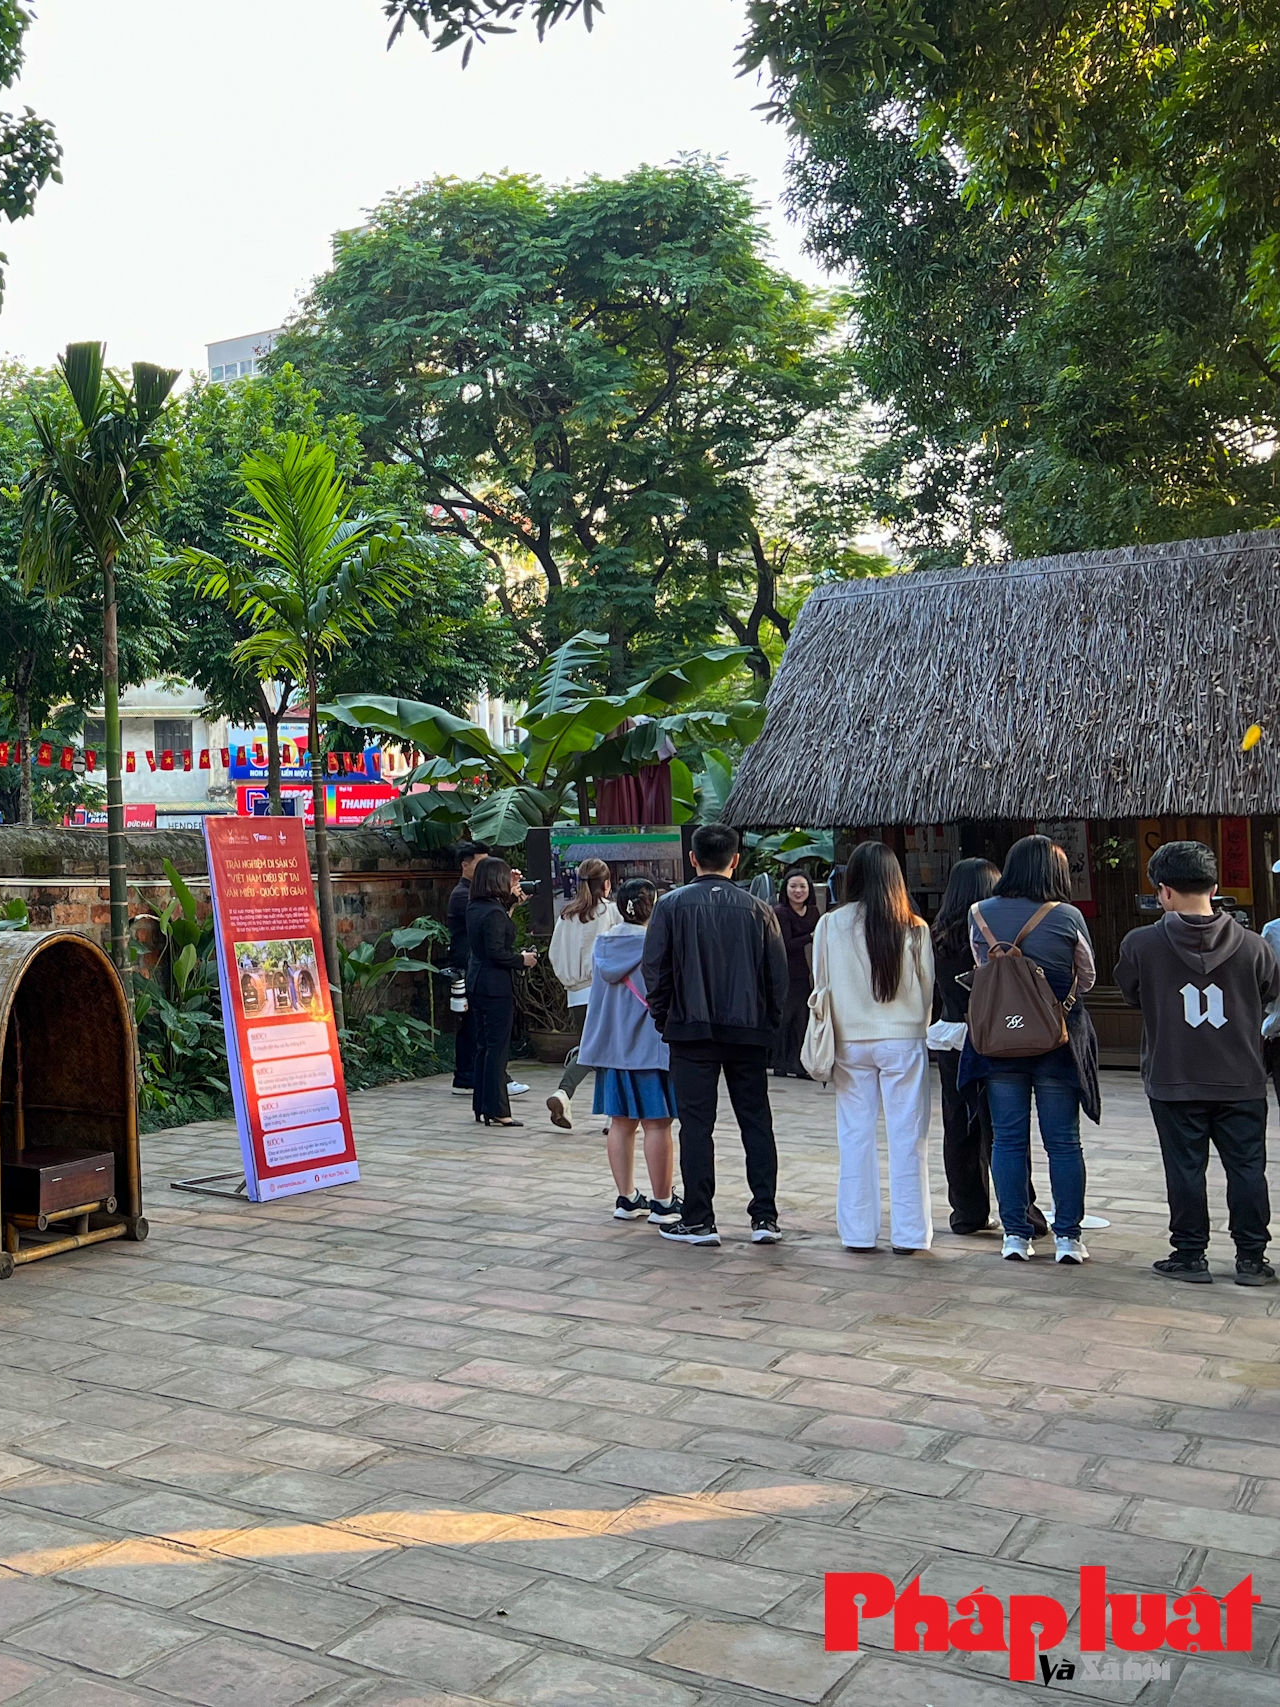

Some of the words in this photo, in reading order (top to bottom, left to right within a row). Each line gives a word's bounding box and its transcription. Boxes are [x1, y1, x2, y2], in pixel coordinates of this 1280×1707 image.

[341, 799, 374, 809] THANH
[267, 859, 275, 869] DI
[245, 873, 262, 883] NAM
